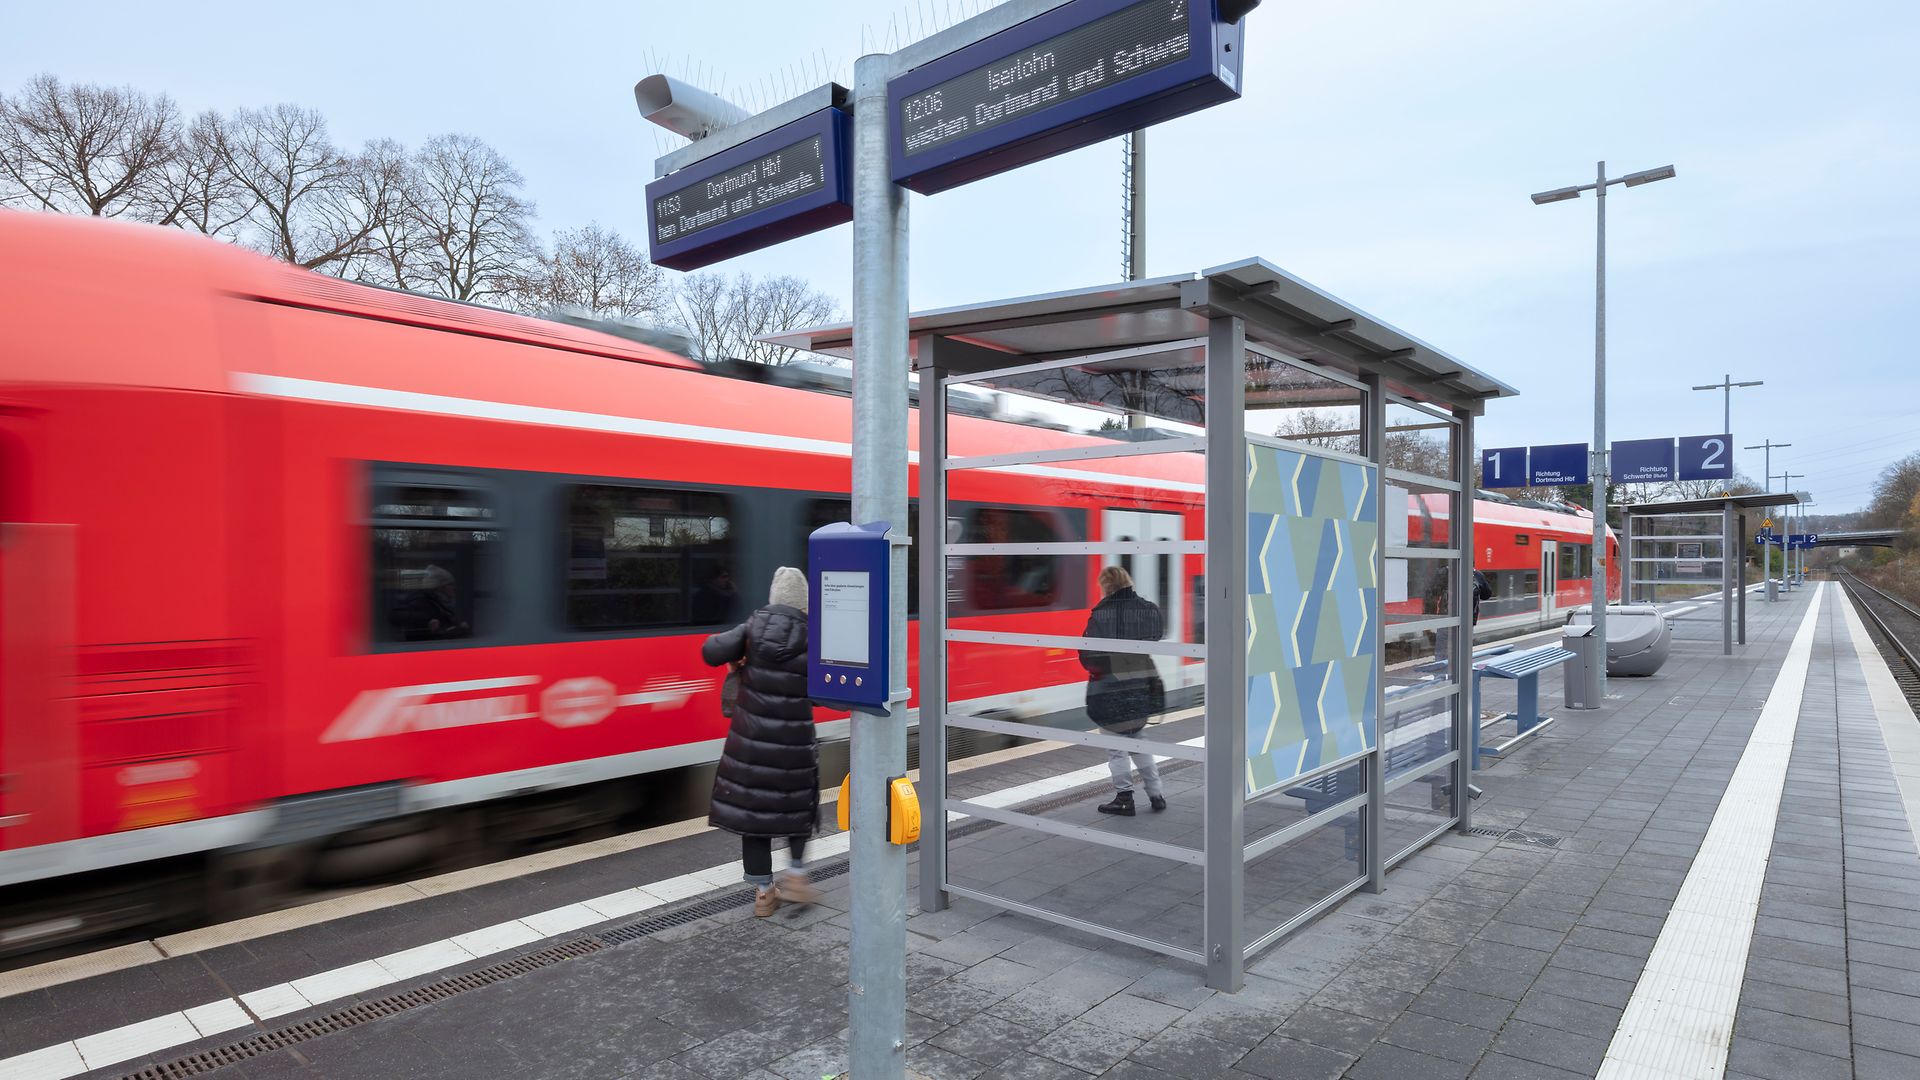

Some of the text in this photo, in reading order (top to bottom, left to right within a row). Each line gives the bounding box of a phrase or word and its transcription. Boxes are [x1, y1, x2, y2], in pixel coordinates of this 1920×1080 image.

[904, 0, 1184, 123] 12:06 Iserlohn 2
[975, 75, 1059, 126] Dortmund
[1067, 58, 1104, 92] und
[656, 139, 820, 218] 11:53 Dortmund Hbf 1
[657, 223, 677, 240] hen
[679, 199, 728, 232] Dortmund
[731, 190, 753, 213] und
[756, 171, 816, 204] Schwerte
[1488, 452, 1500, 479] 1
[1701, 438, 1725, 470] 2
[1756, 535, 1761, 543] 1
[1809, 534, 1817, 543] 2
